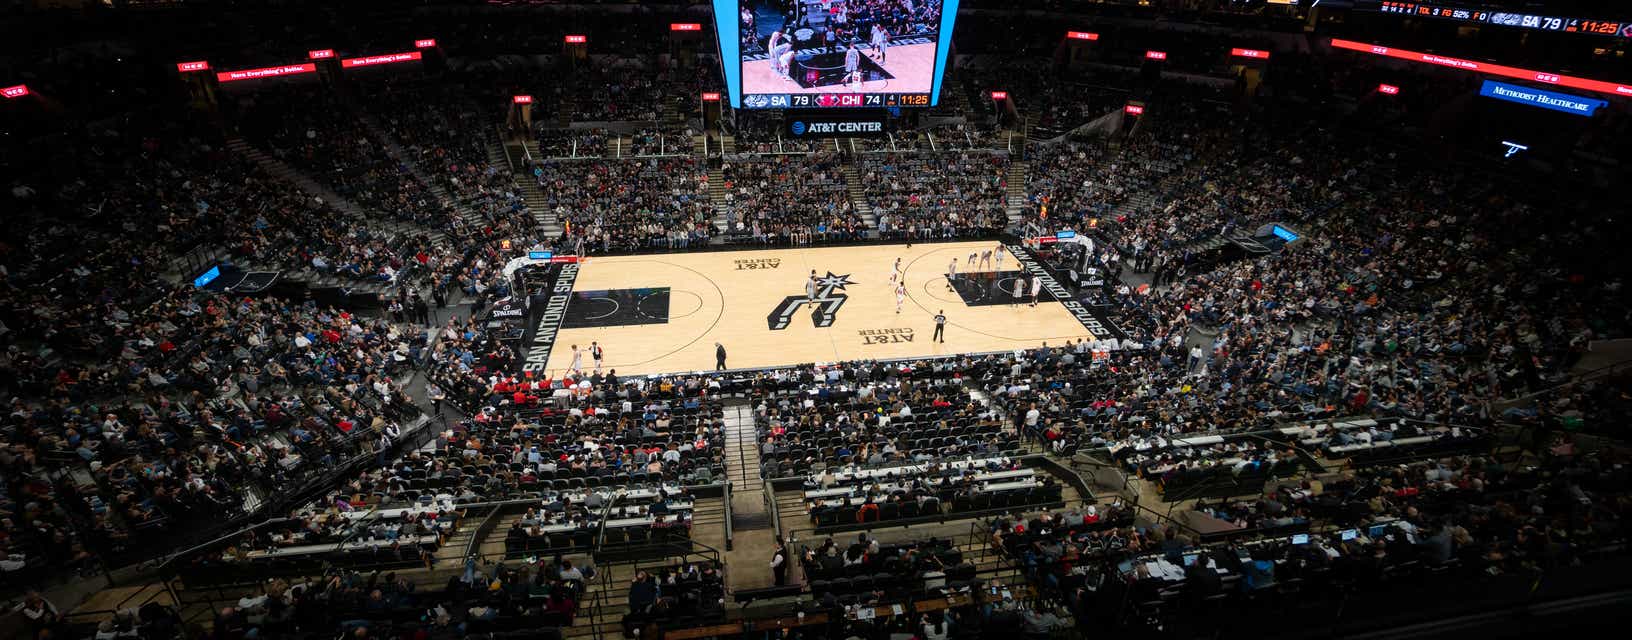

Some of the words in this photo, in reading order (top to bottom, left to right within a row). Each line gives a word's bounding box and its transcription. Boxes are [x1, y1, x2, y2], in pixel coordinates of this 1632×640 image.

[1433, 8, 1439, 16] 3
[1442, 9, 1452, 17] FG
[1453, 10, 1469, 19] 52%
[1522, 15, 1538, 28] SA
[1542, 18, 1561, 30] 79
[1582, 21, 1618, 34] 11:25
[771, 97, 787, 106] SA
[794, 96, 808, 105] 79
[842, 96, 860, 105] CHI
[866, 96, 880, 104] 74
[901, 95, 928, 104] 11:25
[808, 123, 835, 133] AT&T
[837, 122, 881, 132] CENTER
[735, 262, 780, 270] AT&T
[553, 263, 578, 293] SPURS
[1026, 261, 1071, 298] ANTONIO
[1063, 300, 1110, 336] SPURS
[493, 308, 522, 317] SPALDING
[534, 295, 567, 343] ANTONIO
[858, 327, 913, 335] CENTER
[863, 333, 914, 345] AT&T
[522, 345, 550, 371] SAN
